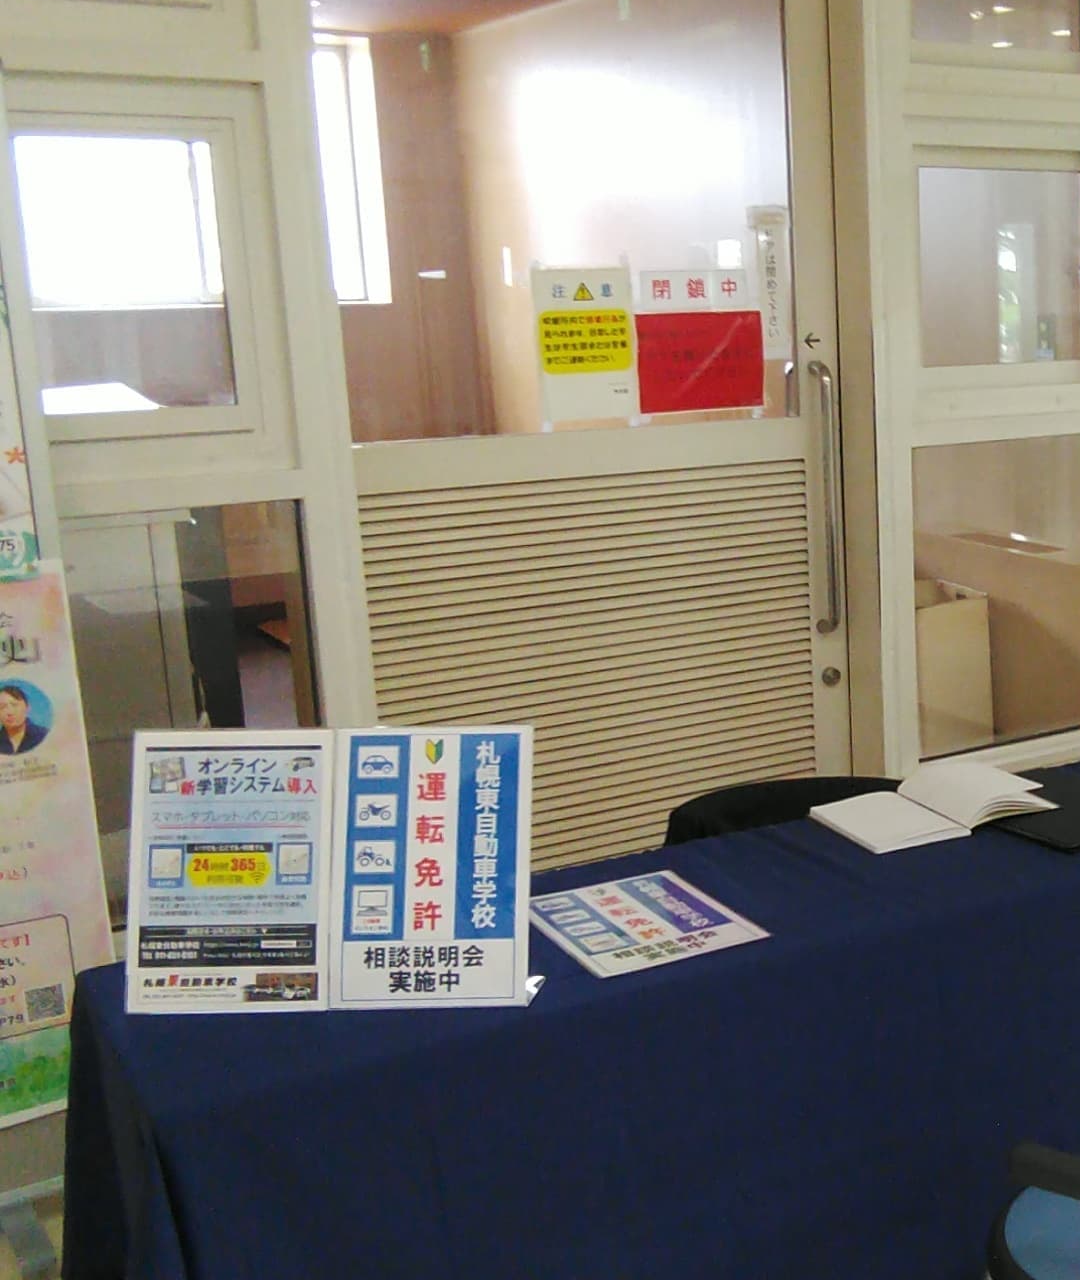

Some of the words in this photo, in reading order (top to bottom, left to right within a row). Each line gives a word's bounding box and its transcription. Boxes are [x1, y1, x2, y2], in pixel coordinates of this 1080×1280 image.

[652, 278, 738, 300] 閉鎖中
[198, 758, 278, 775] オンライン
[181, 777, 319, 796] 新学習システム導入
[471, 741, 501, 929] 札幌東自動車学校
[413, 772, 447, 931] 運転免許
[363, 945, 485, 969] 相談説明会
[388, 970, 461, 994] 実施中
